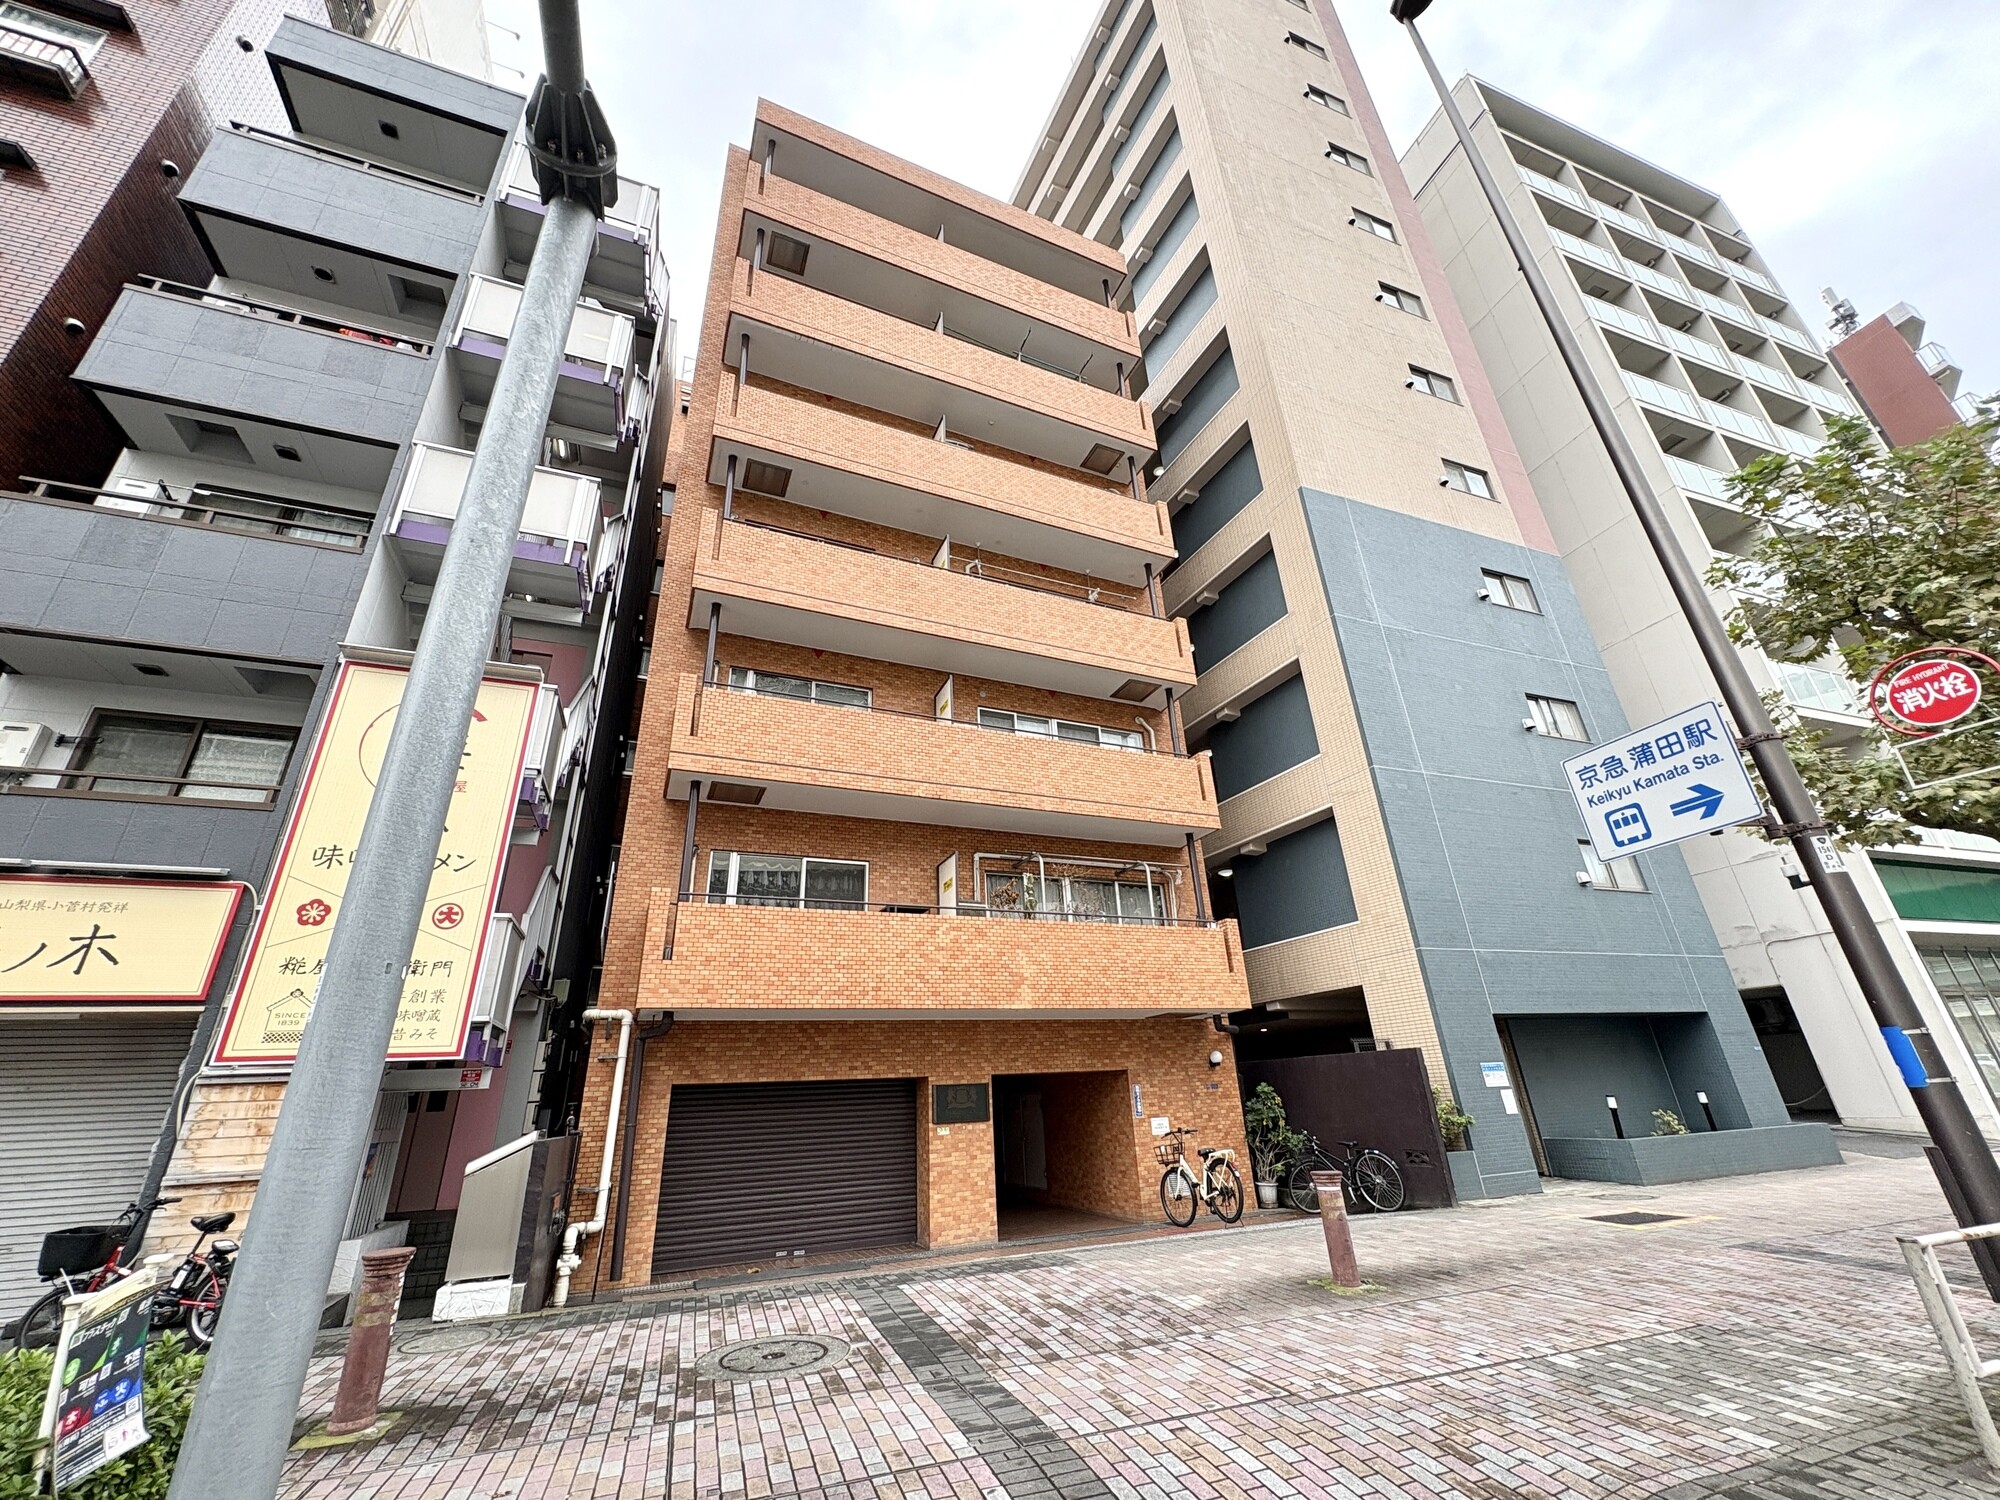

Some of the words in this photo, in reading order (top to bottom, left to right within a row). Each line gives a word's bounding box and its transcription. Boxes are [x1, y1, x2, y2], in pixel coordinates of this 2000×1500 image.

[1893, 676, 1912, 688] FIRE
[1912, 663, 1950, 681] HYDRANT
[1893, 671, 1974, 714] 消火栓
[1575, 718, 1718, 790] 京急蒲田駅
[1586, 785, 1632, 808] Keikyu
[1633, 764, 1690, 792] Kamata
[1694, 752, 1725, 770] Sta.
